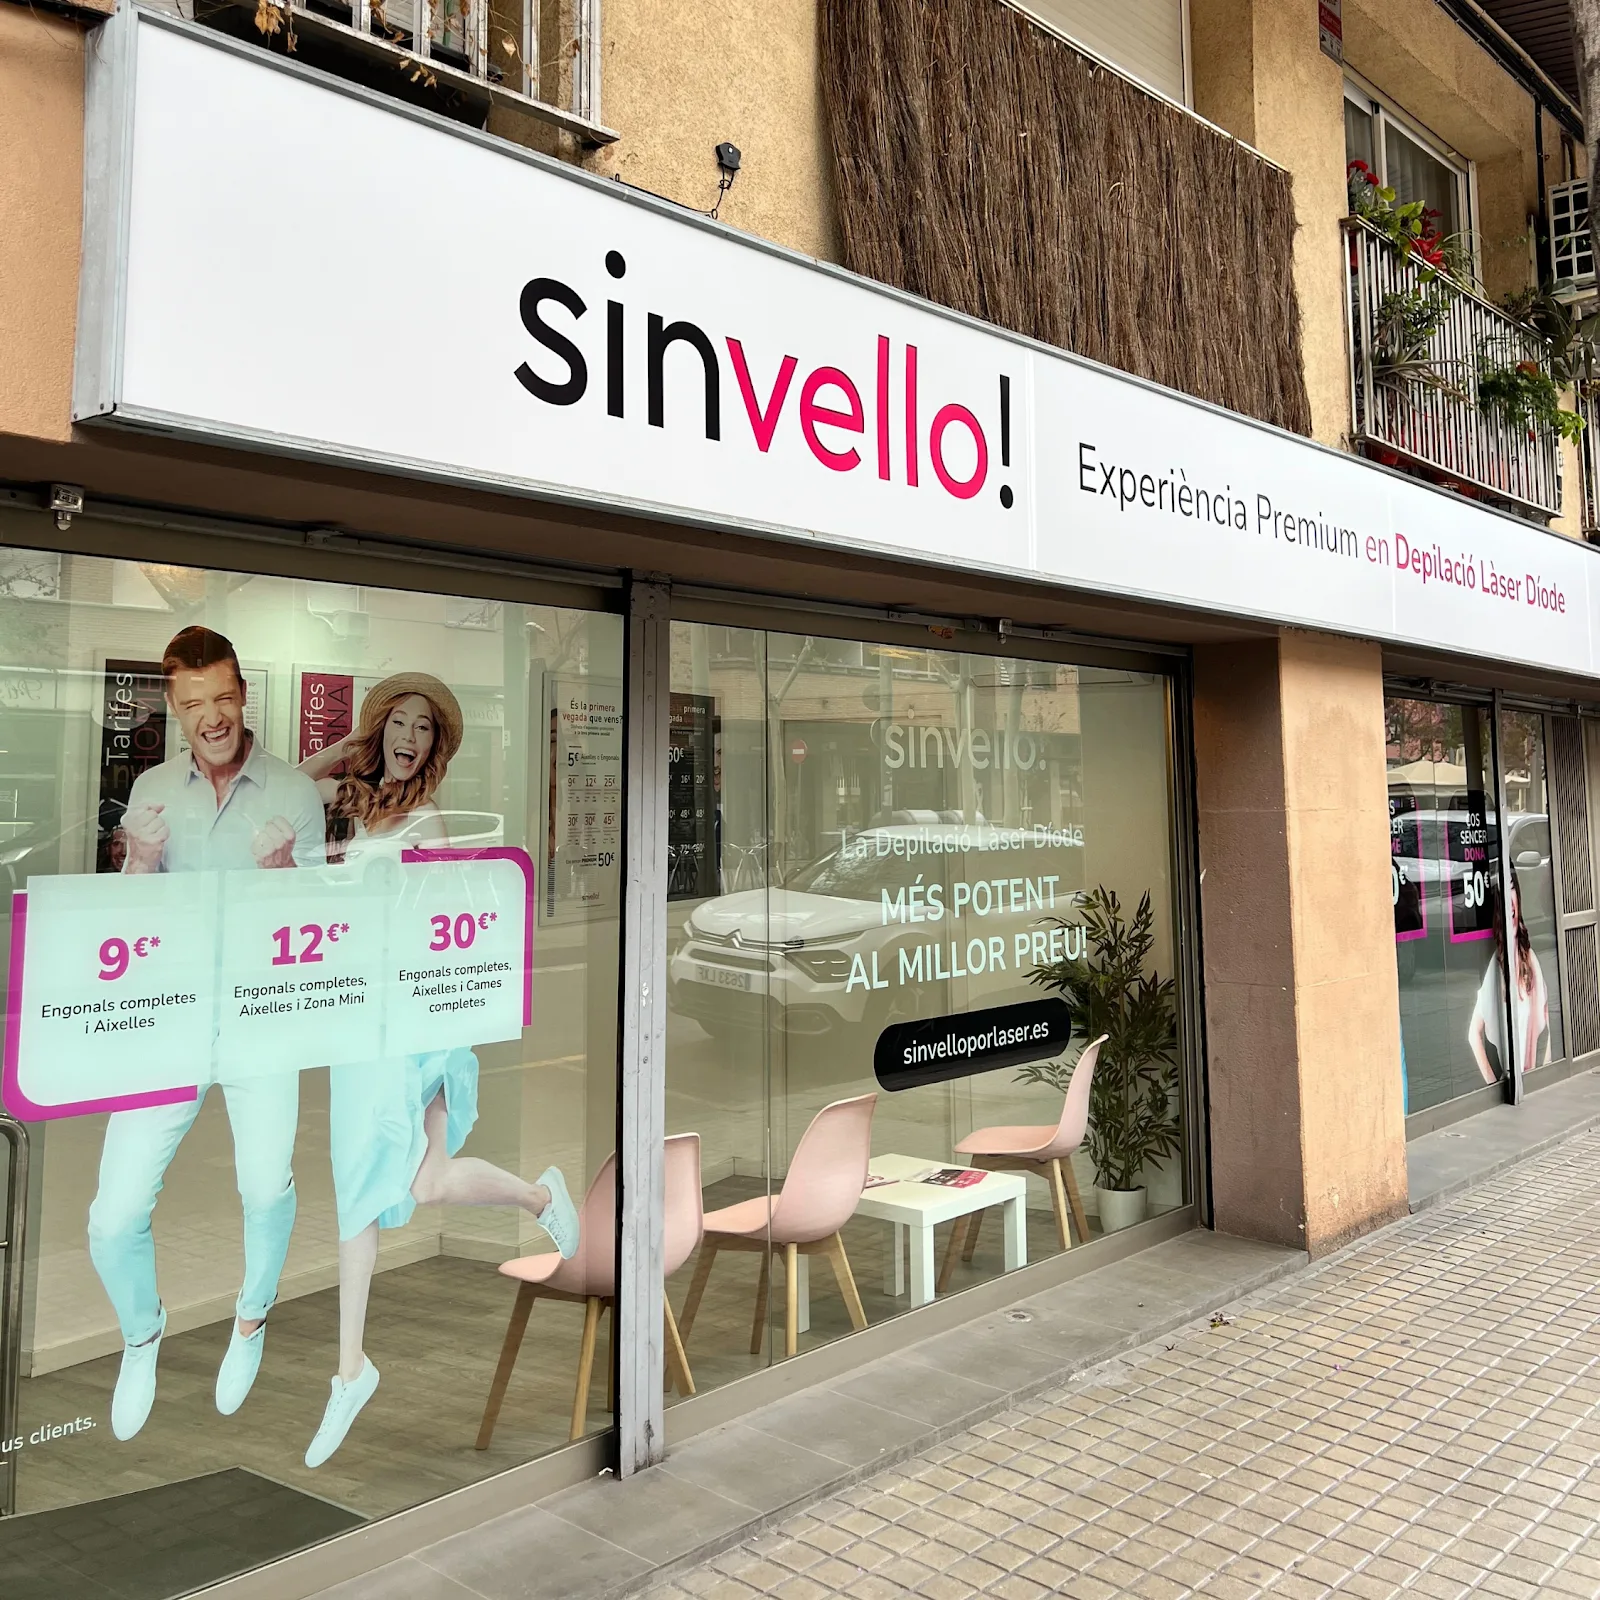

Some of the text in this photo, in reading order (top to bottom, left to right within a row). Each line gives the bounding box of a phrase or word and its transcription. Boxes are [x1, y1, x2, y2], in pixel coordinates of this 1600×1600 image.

[513, 250, 1014, 509] sinvello!
[1079, 442, 1566, 614] Experiència Premium en Depilació Làser Díode
[570, 698, 616, 713] És la primera
[683, 704, 706, 714] primera
[105, 673, 132, 766] Tarifes
[562, 713, 623, 724] vegada que vens?
[669, 714, 683, 724] gada
[568, 752, 580, 767] 5€
[567, 777, 616, 787] 9€ 12€ 25€
[840, 821, 1085, 861] La Depilació Làser Díode
[1460, 829, 1488, 845] SENCER
[598, 852, 616, 867] 50€
[1464, 847, 1486, 861] DONA
[881, 874, 1060, 925] MÉS POTENT
[1463, 870, 1490, 909] 50€
[845, 926, 1088, 993] AL MILLOR PREU!
[398, 960, 513, 984] Engonals completes,
[234, 976, 368, 1000] Engonals completes,
[411, 977, 503, 998] Aixelles i Cames
[41, 993, 197, 1019] Engonals completes
[239, 993, 365, 1018] Aixelles i Zona Mini
[428, 997, 487, 1013] completes
[84, 1016, 156, 1034] i Aixelles
[903, 1020, 1049, 1065] sinvelloporlaser.es
[29, 1416, 98, 1445] clients.
